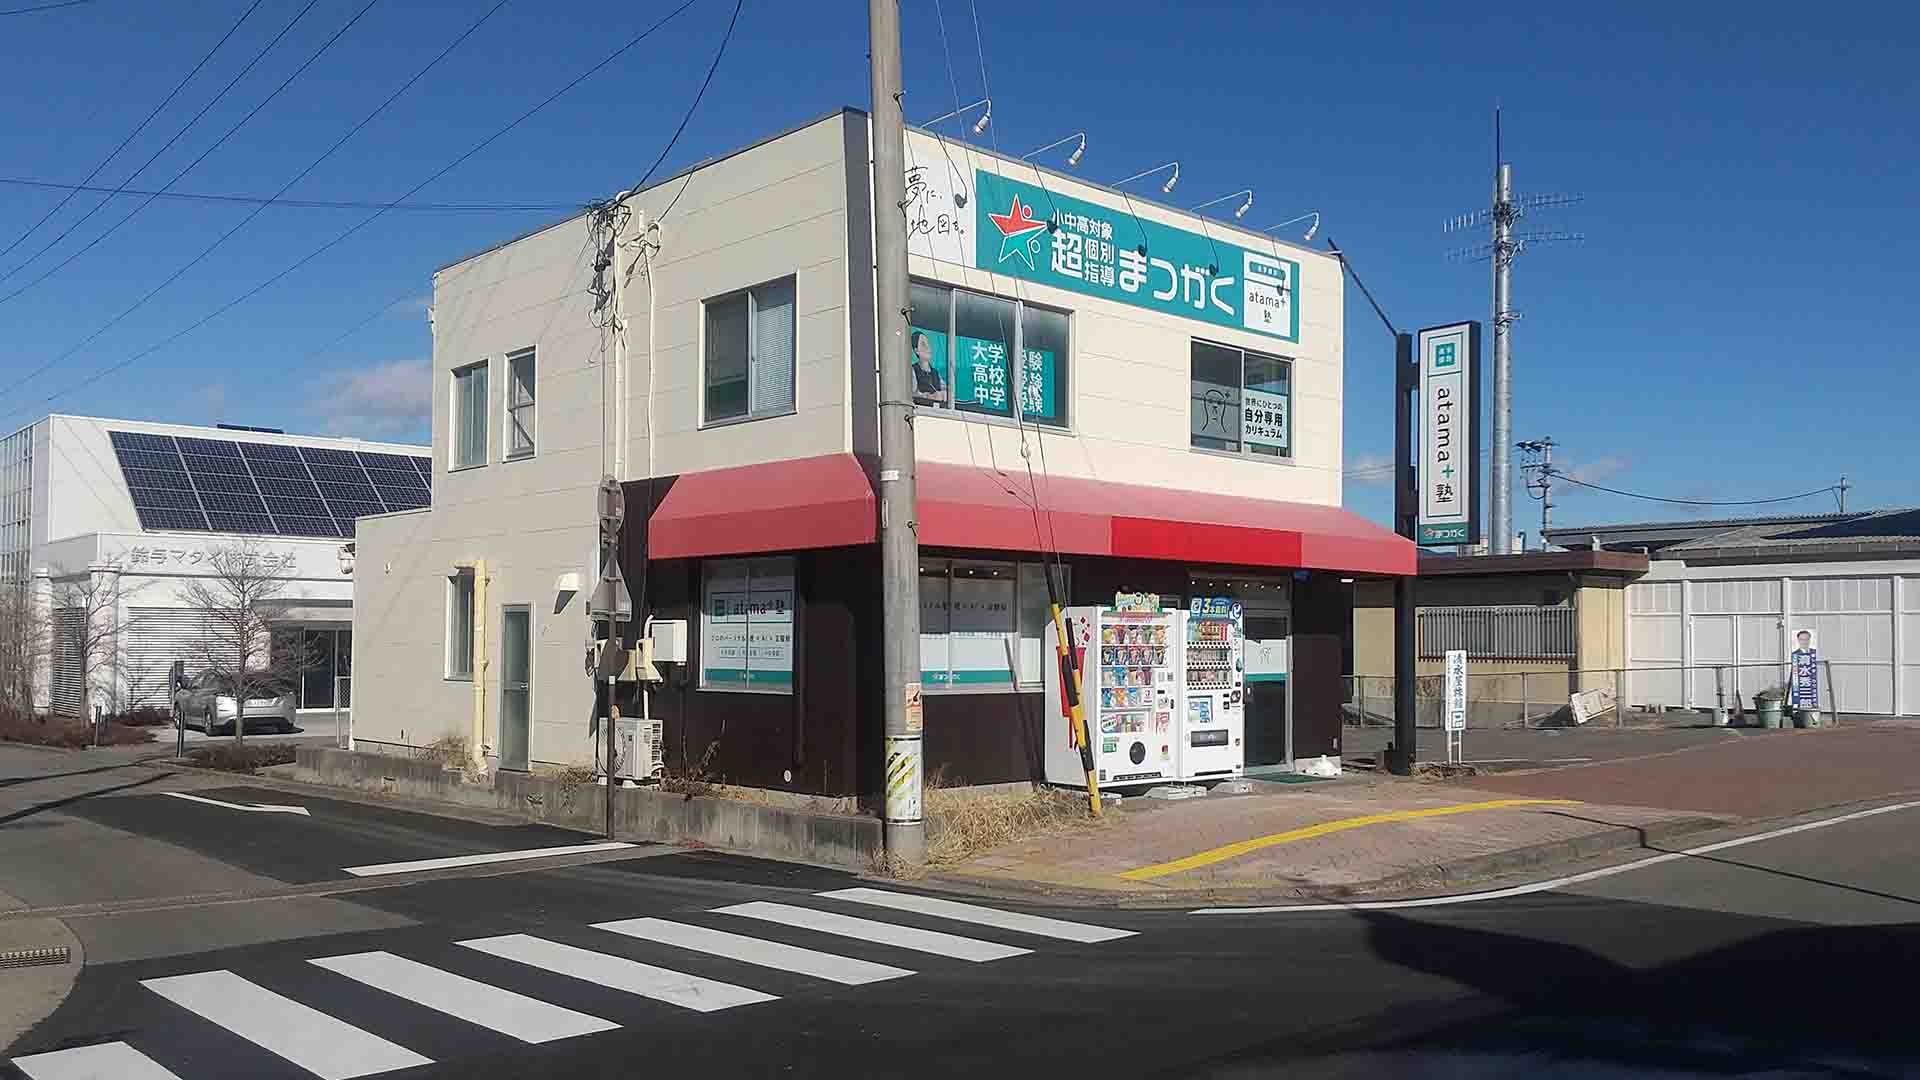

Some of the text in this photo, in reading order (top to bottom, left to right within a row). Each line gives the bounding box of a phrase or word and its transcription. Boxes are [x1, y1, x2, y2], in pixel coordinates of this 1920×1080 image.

[1051, 208, 1113, 242] 小中高対象
[1051, 229, 1083, 279] 超
[1084, 237, 1115, 265] 個別
[1084, 263, 1115, 288] 指導
[1119, 248, 1235, 317] まつがく
[971, 341, 1004, 363] 大学
[971, 362, 1005, 386] 高校
[973, 385, 1005, 406] 中学
[1245, 408, 1283, 427] 自分専用
[1245, 423, 1282, 439] カリキュラム
[1435, 483, 1453, 503] 塾
